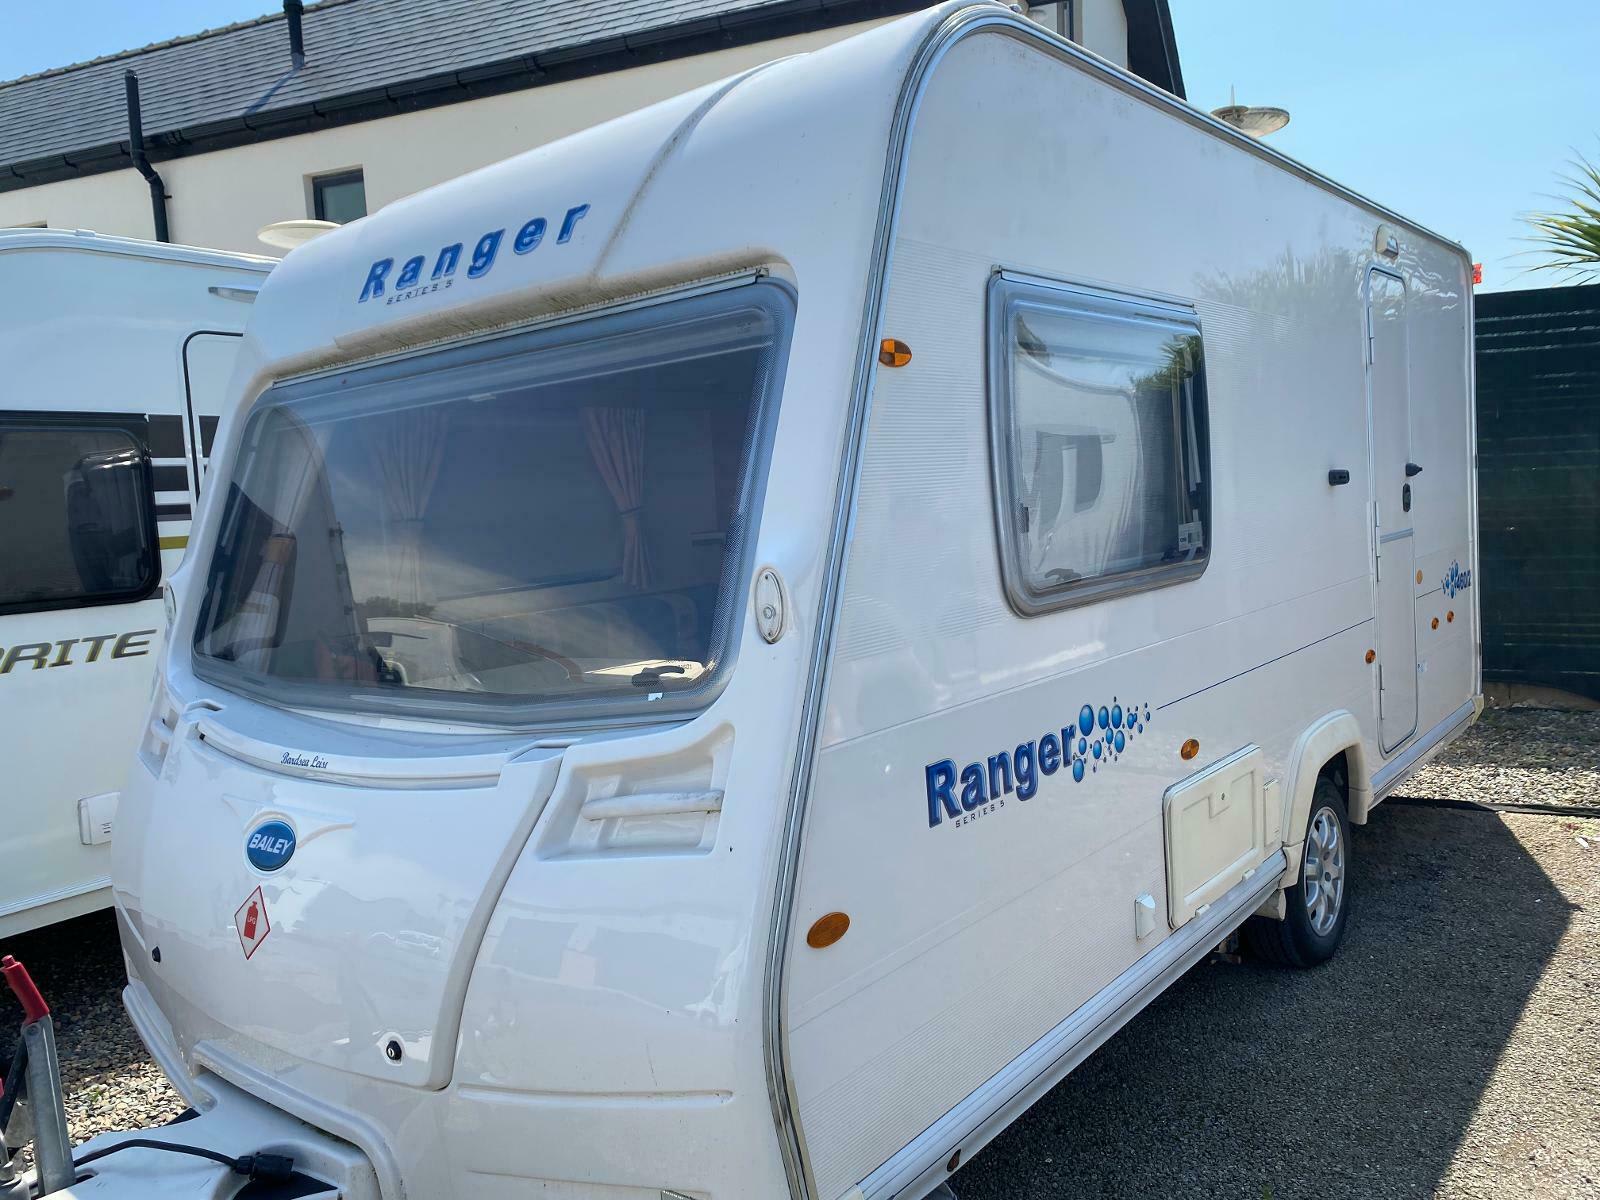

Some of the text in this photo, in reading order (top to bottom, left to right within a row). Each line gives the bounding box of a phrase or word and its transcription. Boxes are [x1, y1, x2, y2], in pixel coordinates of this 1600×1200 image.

[358, 203, 591, 303] Ranger
[386, 282, 438, 305] SERIES
[0, 629, 157, 674] RITE
[925, 723, 1077, 828] Ranger
[955, 803, 995, 828] SERIES
[249, 833, 293, 855] BAILEY
